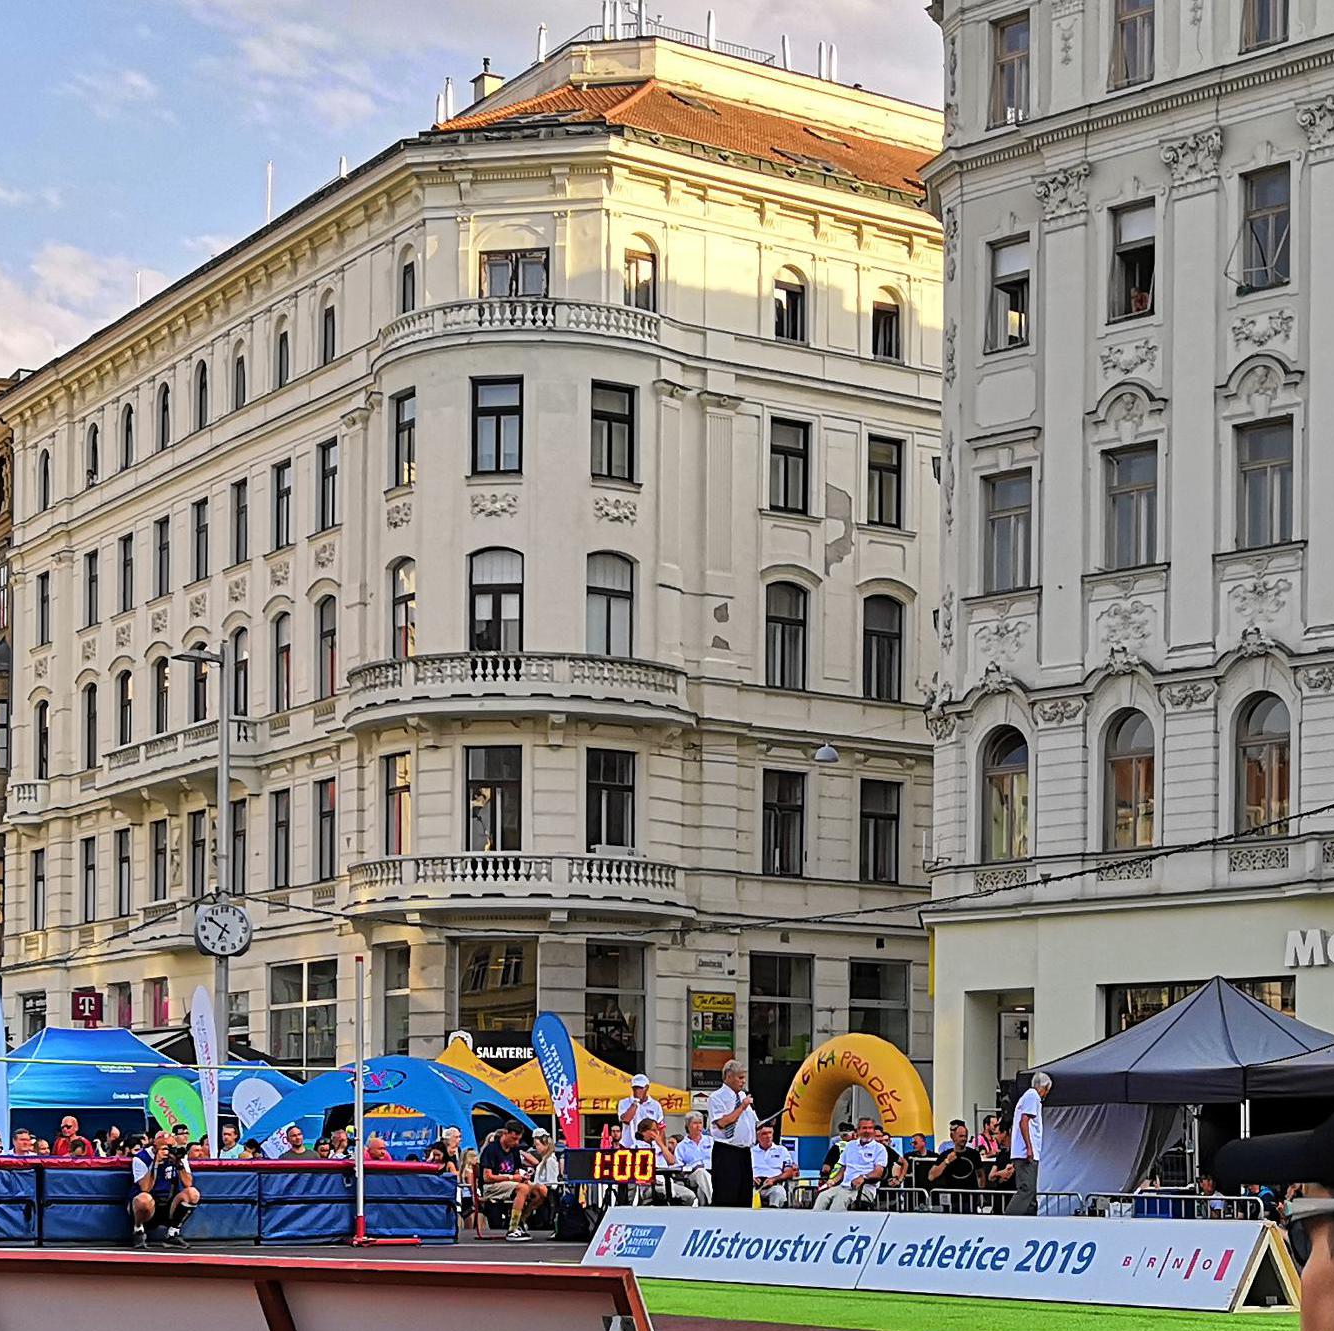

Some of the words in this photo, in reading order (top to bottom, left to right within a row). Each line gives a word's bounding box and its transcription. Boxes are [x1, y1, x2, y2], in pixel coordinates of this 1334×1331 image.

[476, 1047, 534, 1060] SALATERIE
[840, 1051, 870, 1078] PRO
[868, 1076, 902, 1124] DĚTI
[593, 1149, 655, 1181] 1:00
[681, 1228, 833, 1264] Mistrovství
[831, 1225, 872, 1265] ČR
[876, 1242, 897, 1266] v
[897, 1235, 1012, 1271] atletice
[1014, 1239, 1098, 1275] 2019
